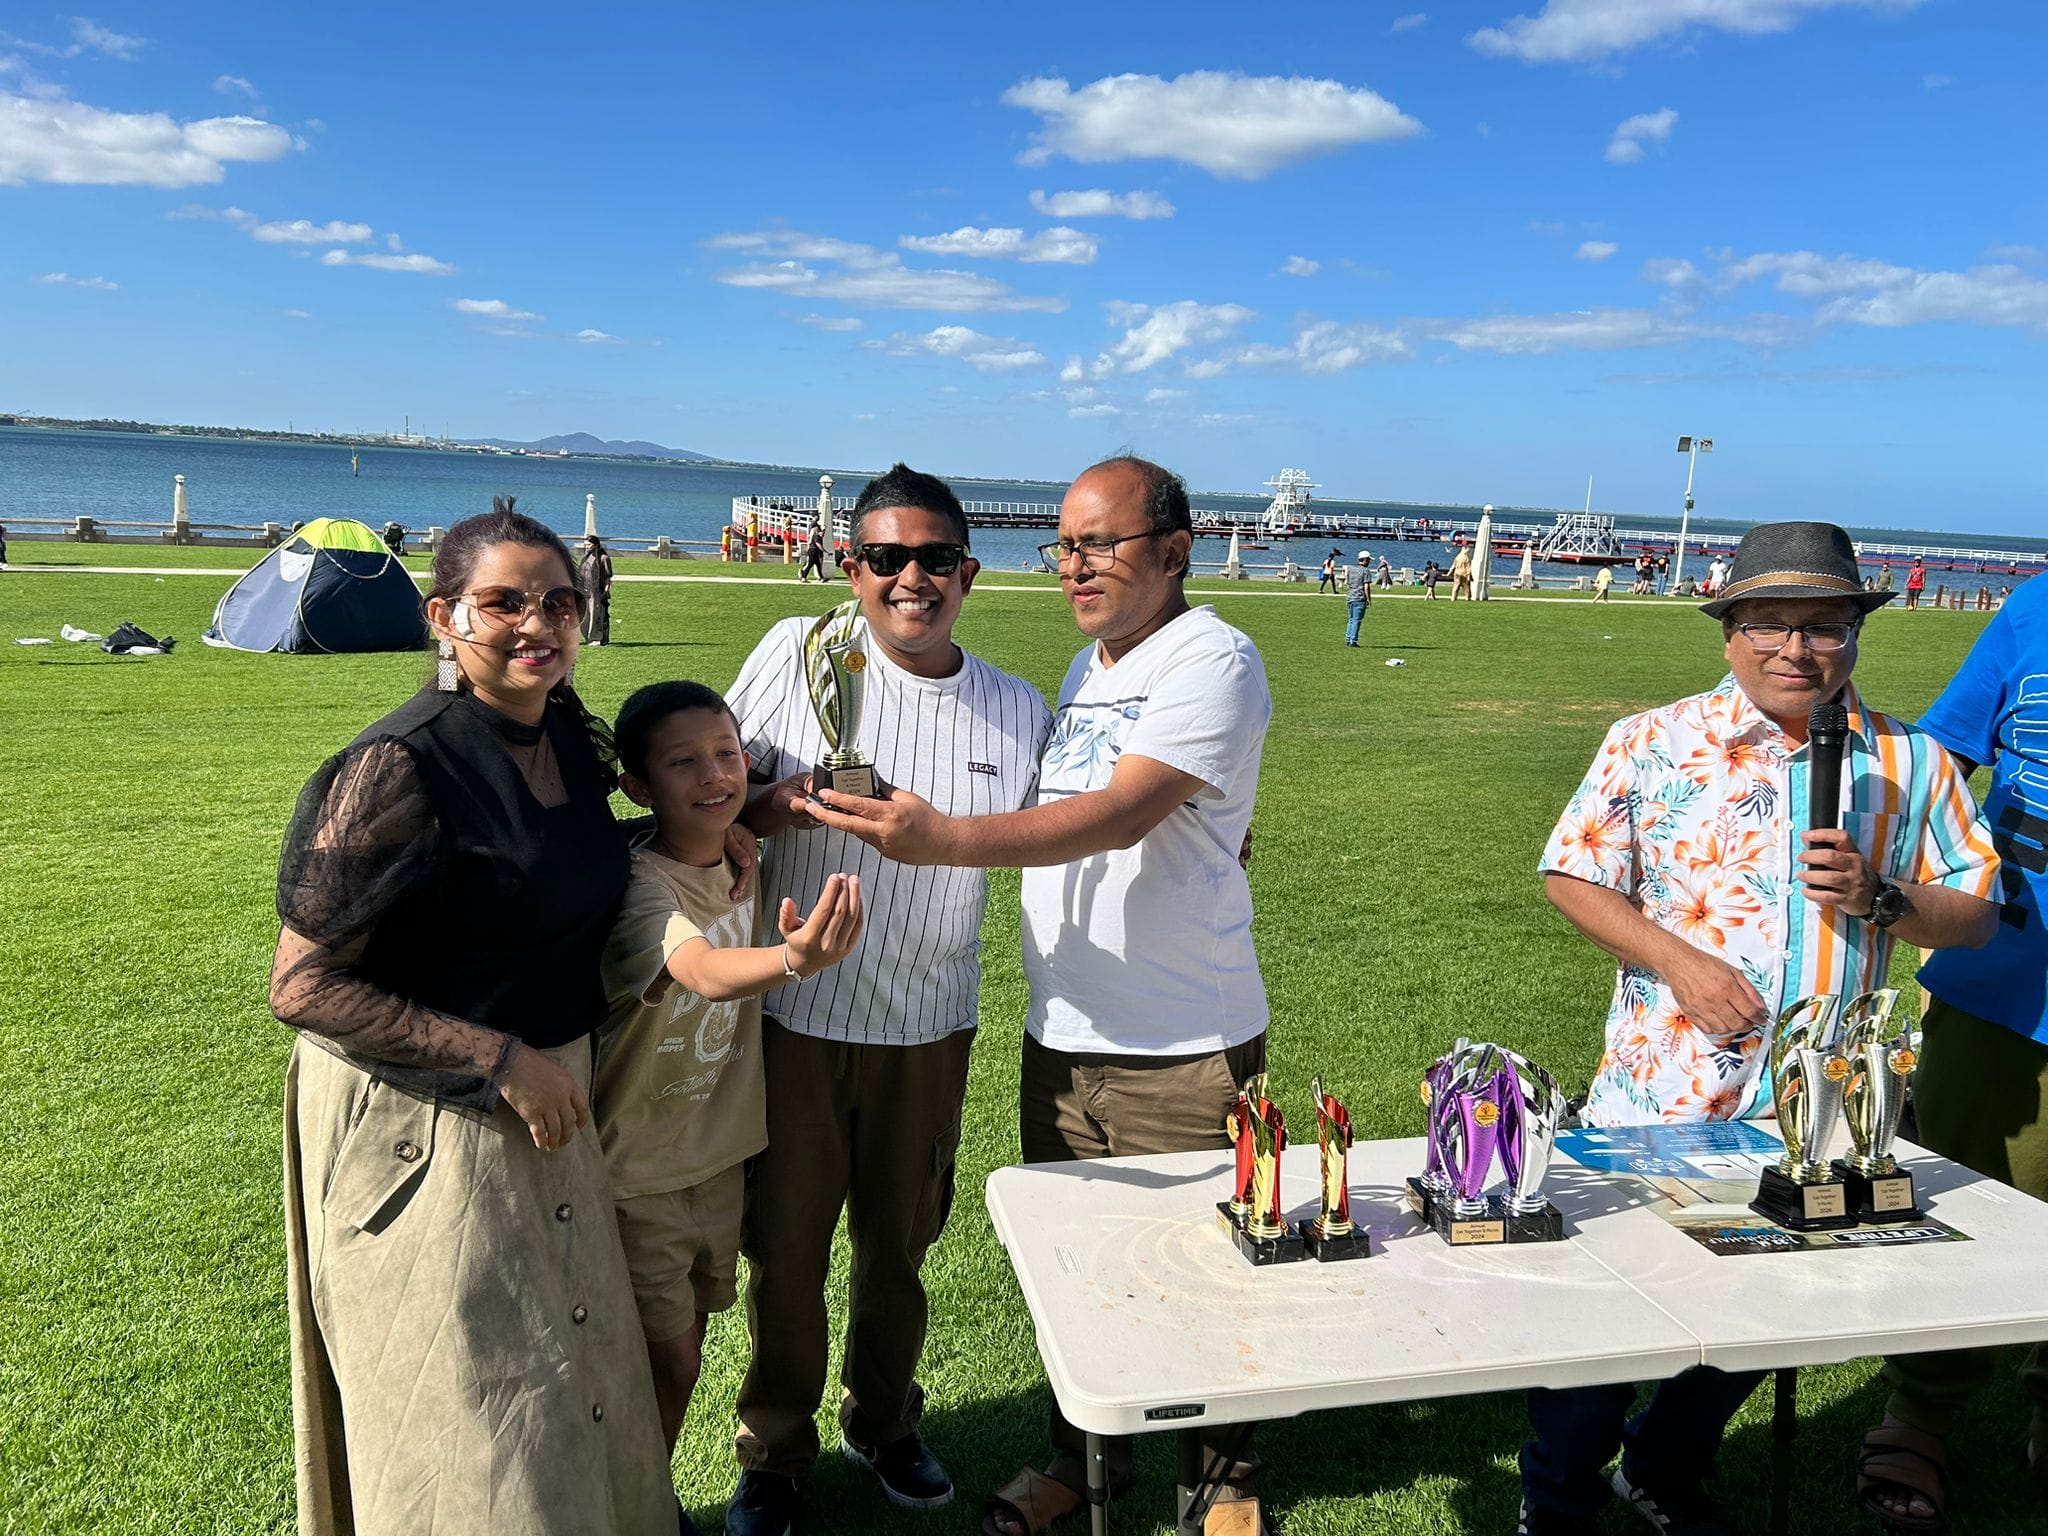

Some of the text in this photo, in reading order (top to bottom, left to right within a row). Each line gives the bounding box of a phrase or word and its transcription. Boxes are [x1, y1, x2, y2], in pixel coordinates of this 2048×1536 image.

[969, 763, 997, 776] LEGACY
[656, 1044, 686, 1054] HOPES
[1843, 1229, 1932, 1242] LIFETIME
[1152, 1407, 1199, 1418] LIFETIME
